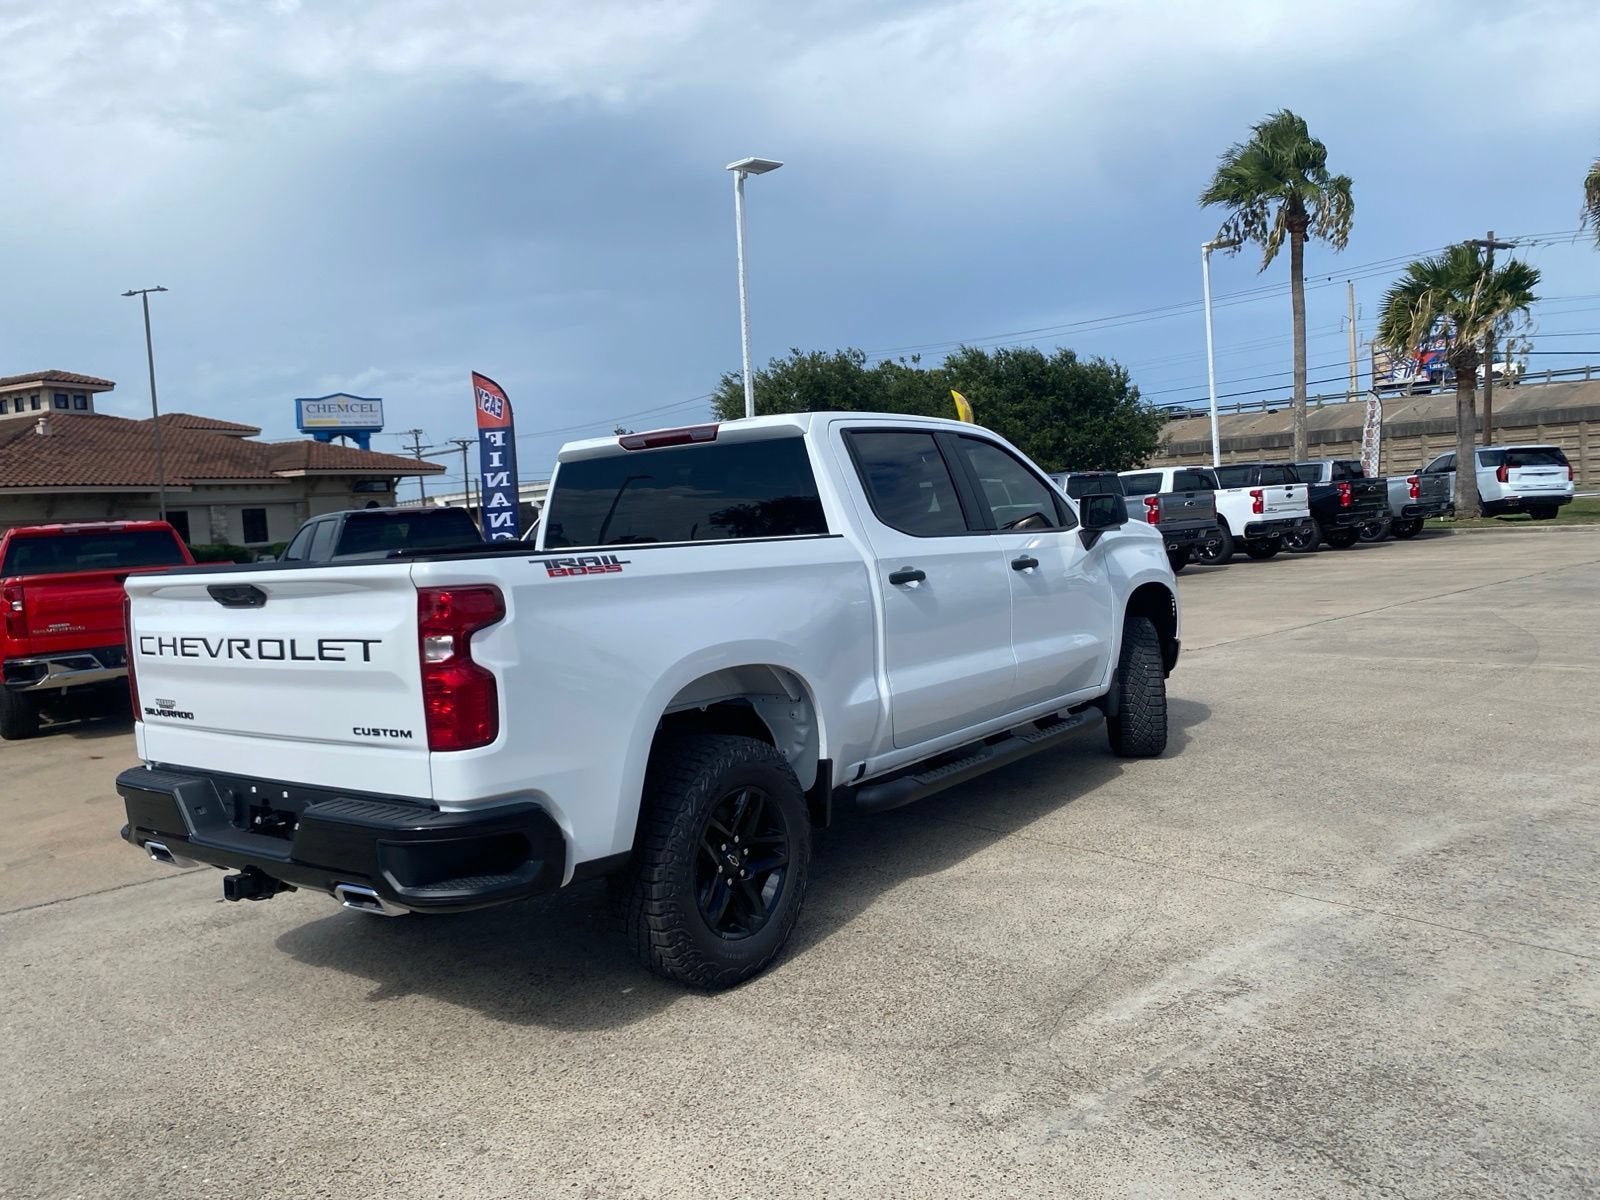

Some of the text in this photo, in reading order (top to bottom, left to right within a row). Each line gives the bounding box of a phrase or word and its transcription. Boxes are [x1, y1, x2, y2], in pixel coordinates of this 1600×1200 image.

[306, 403, 379, 413] CHEMCEL
[528, 555, 631, 569] TRAIL
[547, 564, 623, 578] BOSS
[139, 636, 382, 662] CHEVROLET
[353, 727, 412, 739] CUSTOM
